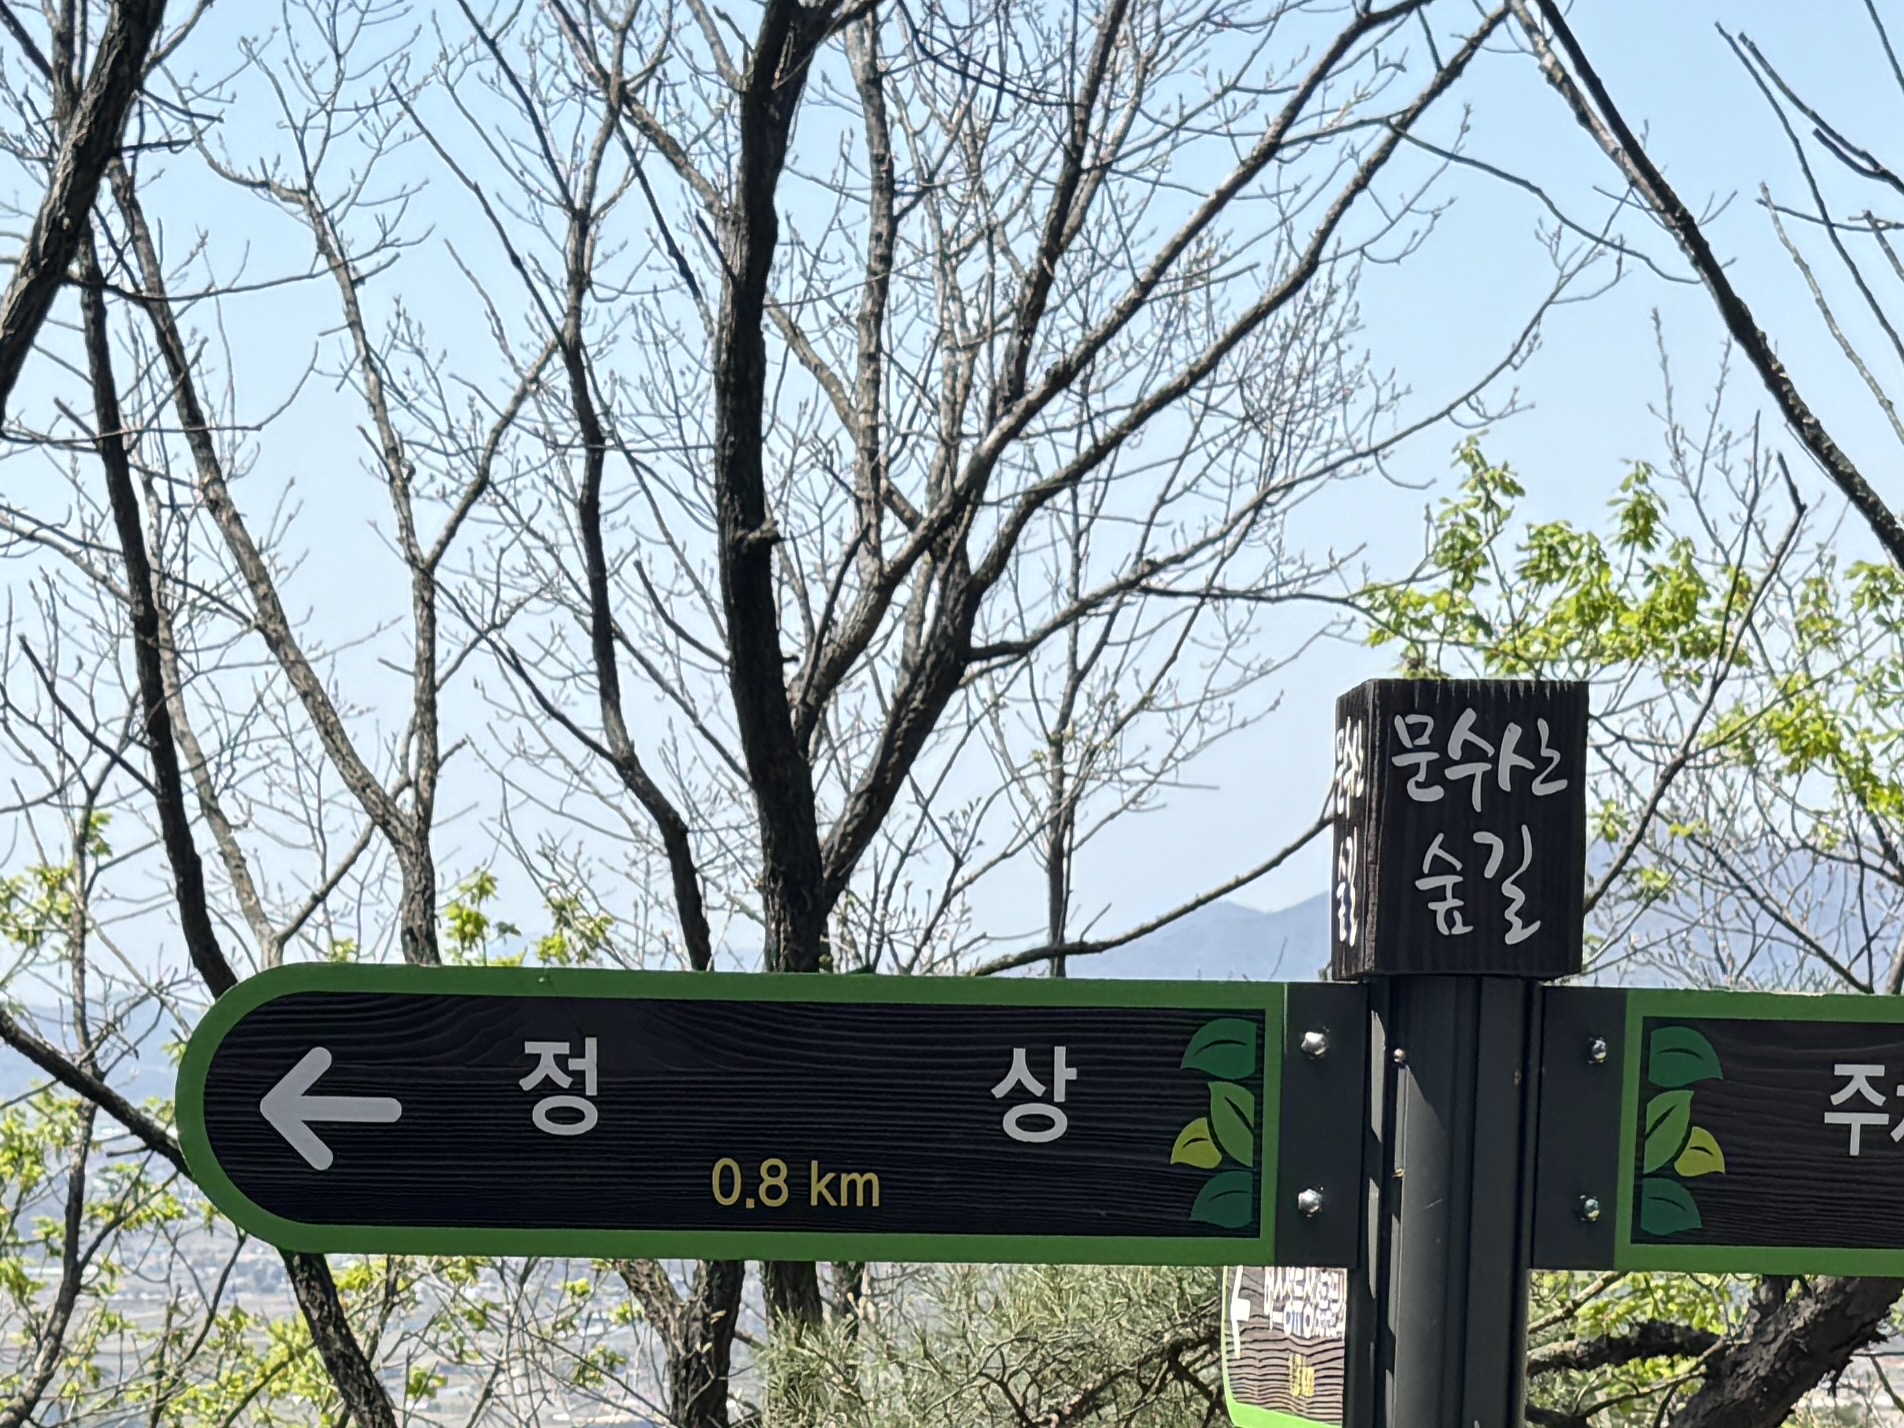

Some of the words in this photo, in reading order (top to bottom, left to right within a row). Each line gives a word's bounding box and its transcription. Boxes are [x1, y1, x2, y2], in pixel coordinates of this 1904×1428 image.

[1392, 708, 1568, 812] 문수산
[1415, 825, 1541, 945] 숲길
[519, 1037, 599, 1136] 정
[991, 1046, 1078, 1143] 상
[711, 1157, 789, 1209] 0.8
[810, 1159, 880, 1207] km
